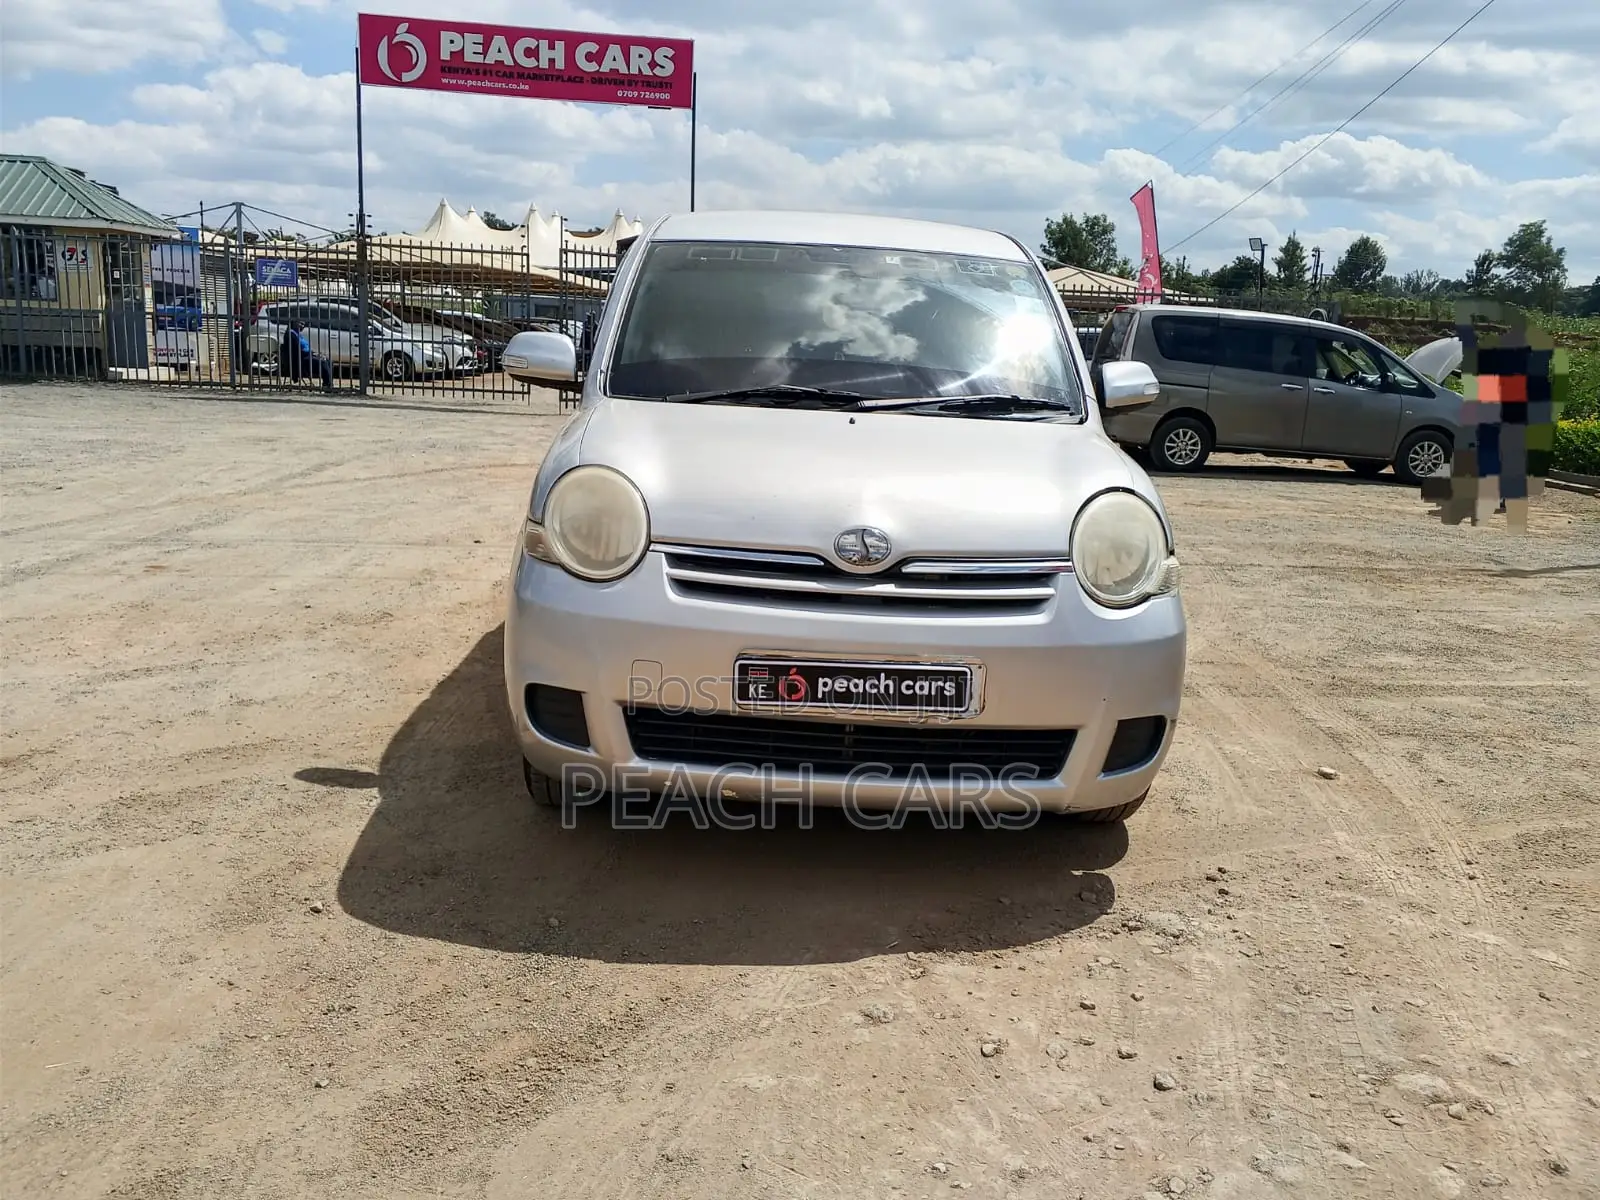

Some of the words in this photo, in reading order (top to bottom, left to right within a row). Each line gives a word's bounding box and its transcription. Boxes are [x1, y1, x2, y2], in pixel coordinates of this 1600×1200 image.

[440, 30, 565, 69] PEACH
[574, 41, 676, 77] CARS
[440, 65, 481, 76] KENYA'S
[495, 70, 515, 79] CAR
[516, 71, 585, 84] MARKETPLACE
[590, 76, 625, 86] DRIVEN
[627, 79, 639, 87] BY
[440, 77, 530, 91] www.peachcars.co.ke
[617, 89, 639, 98] 0709
[639, 91, 671, 100] 726900
[748, 683, 767, 699] KE
[817, 672, 894, 699] peach
[900, 677, 957, 697] cars
